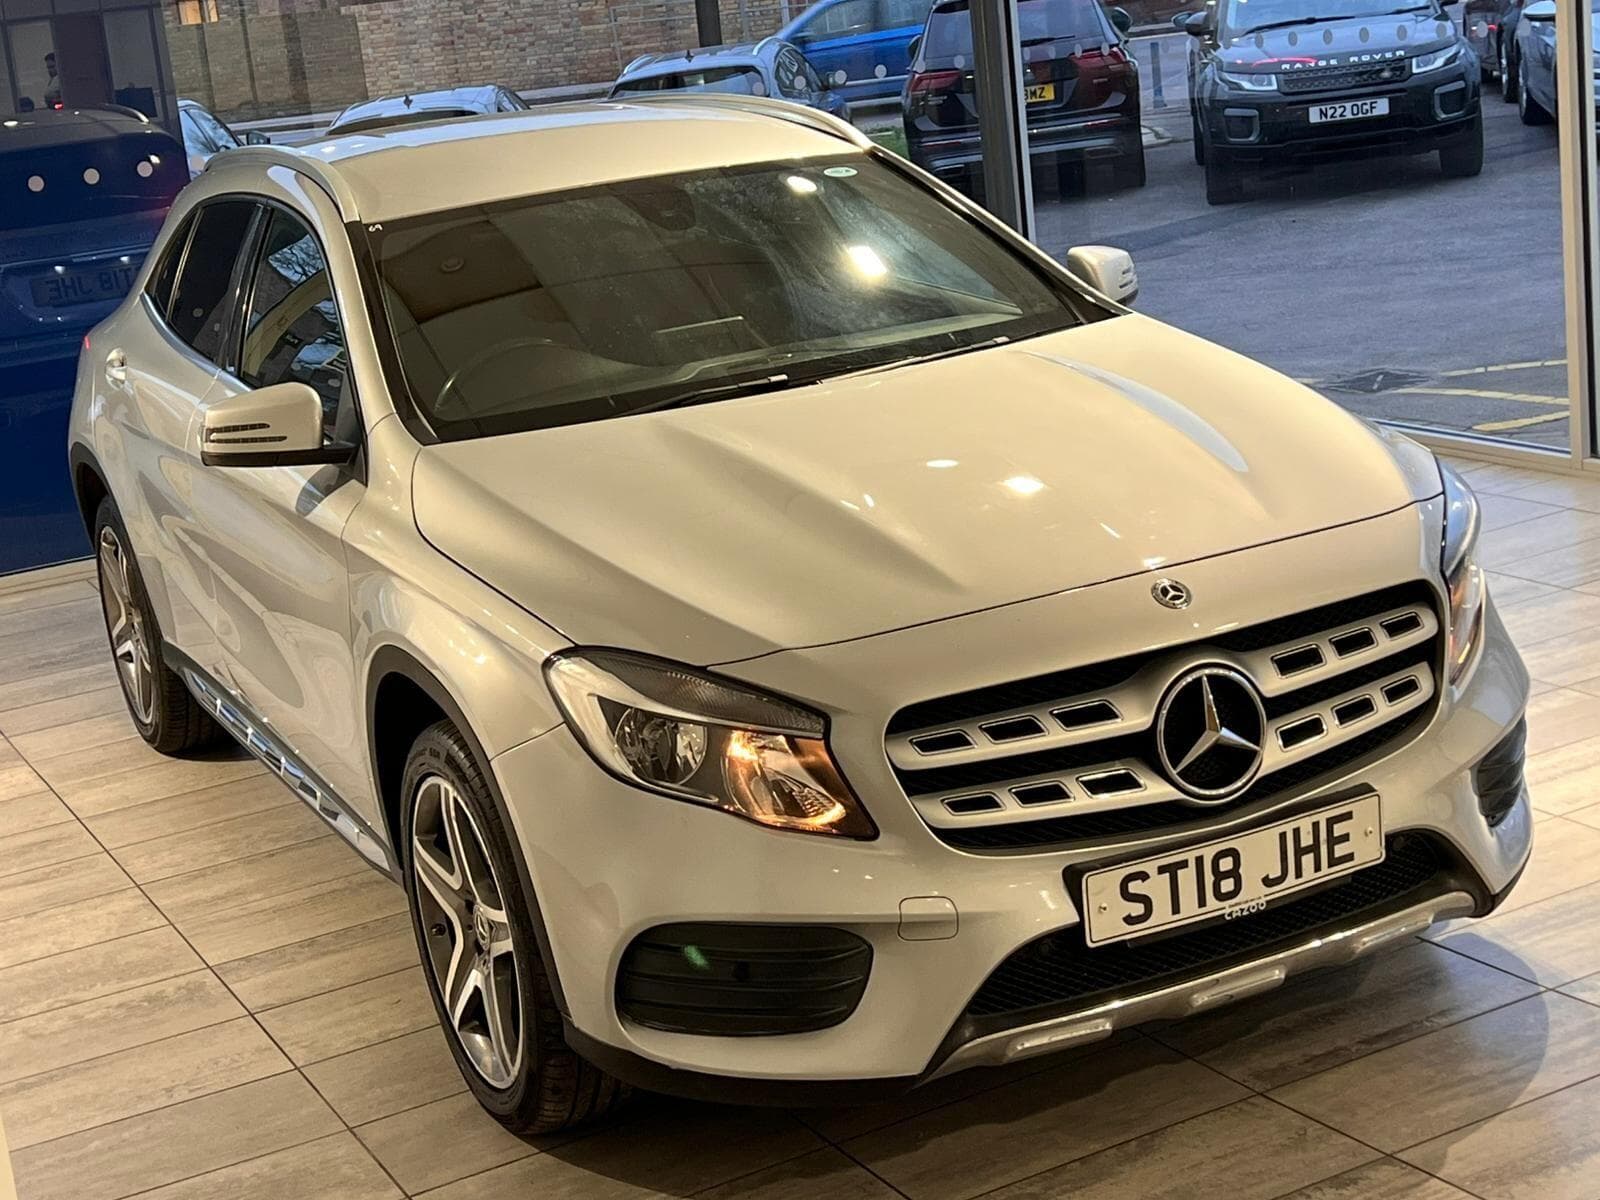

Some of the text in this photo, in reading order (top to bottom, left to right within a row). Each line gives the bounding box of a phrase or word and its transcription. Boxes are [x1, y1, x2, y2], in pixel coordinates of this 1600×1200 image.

[1281, 50, 1405, 70] RANGE ROVER
[1319, 101, 1378, 120] N22 OGF
[1119, 810, 1355, 926] ST18 JHE
